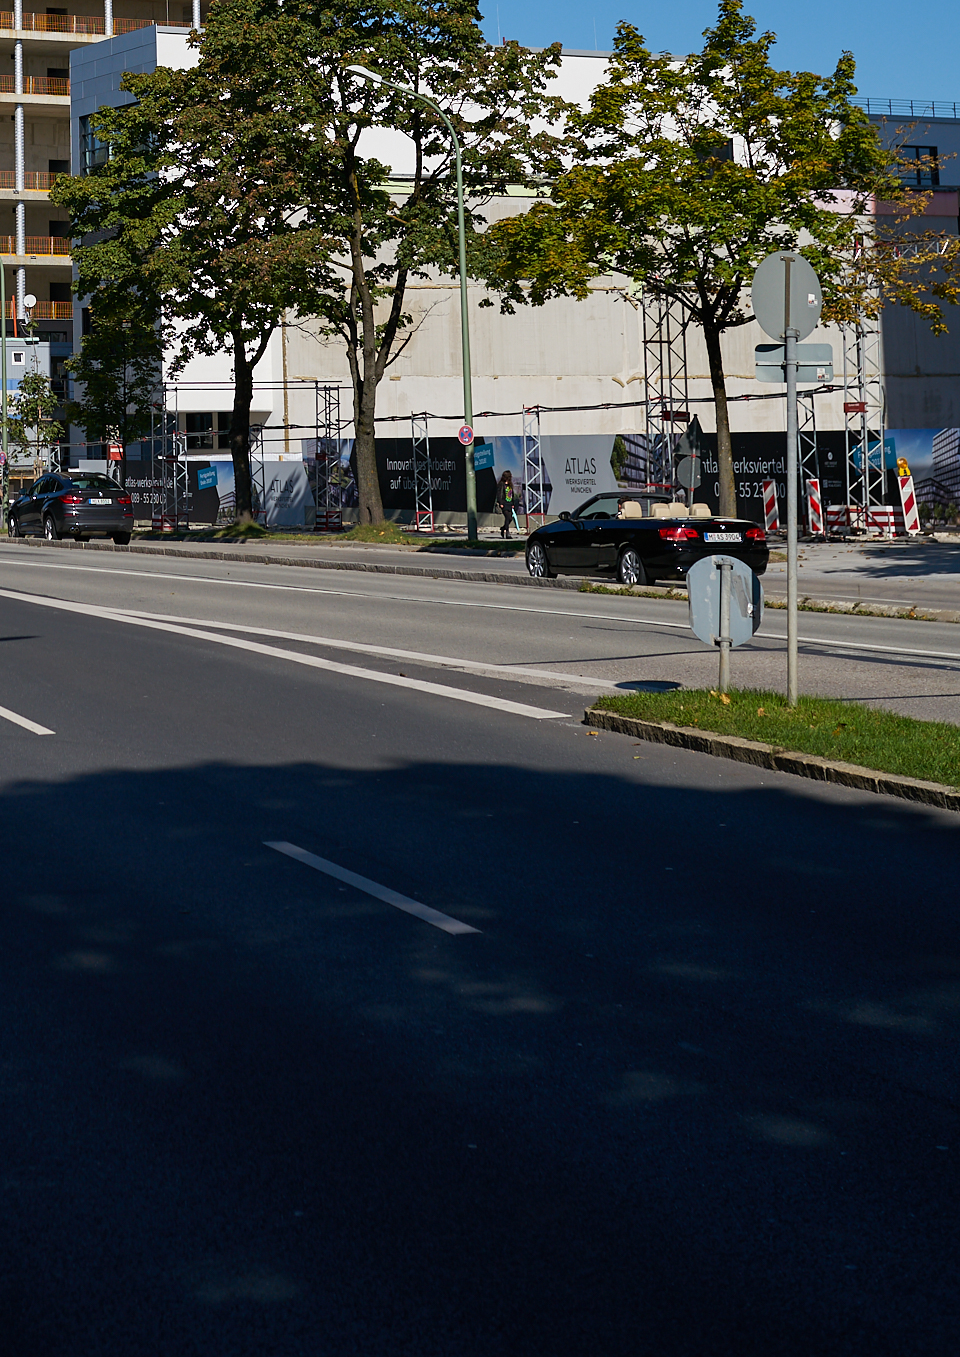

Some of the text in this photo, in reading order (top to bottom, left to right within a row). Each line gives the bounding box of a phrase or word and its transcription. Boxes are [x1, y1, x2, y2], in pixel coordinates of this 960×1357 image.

[565, 458, 597, 474] ATLAS
[390, 476, 401, 490] auf
[739, 482, 752, 498] 55
[130, 492, 140, 504] 089
[143, 492, 150, 505] 55
